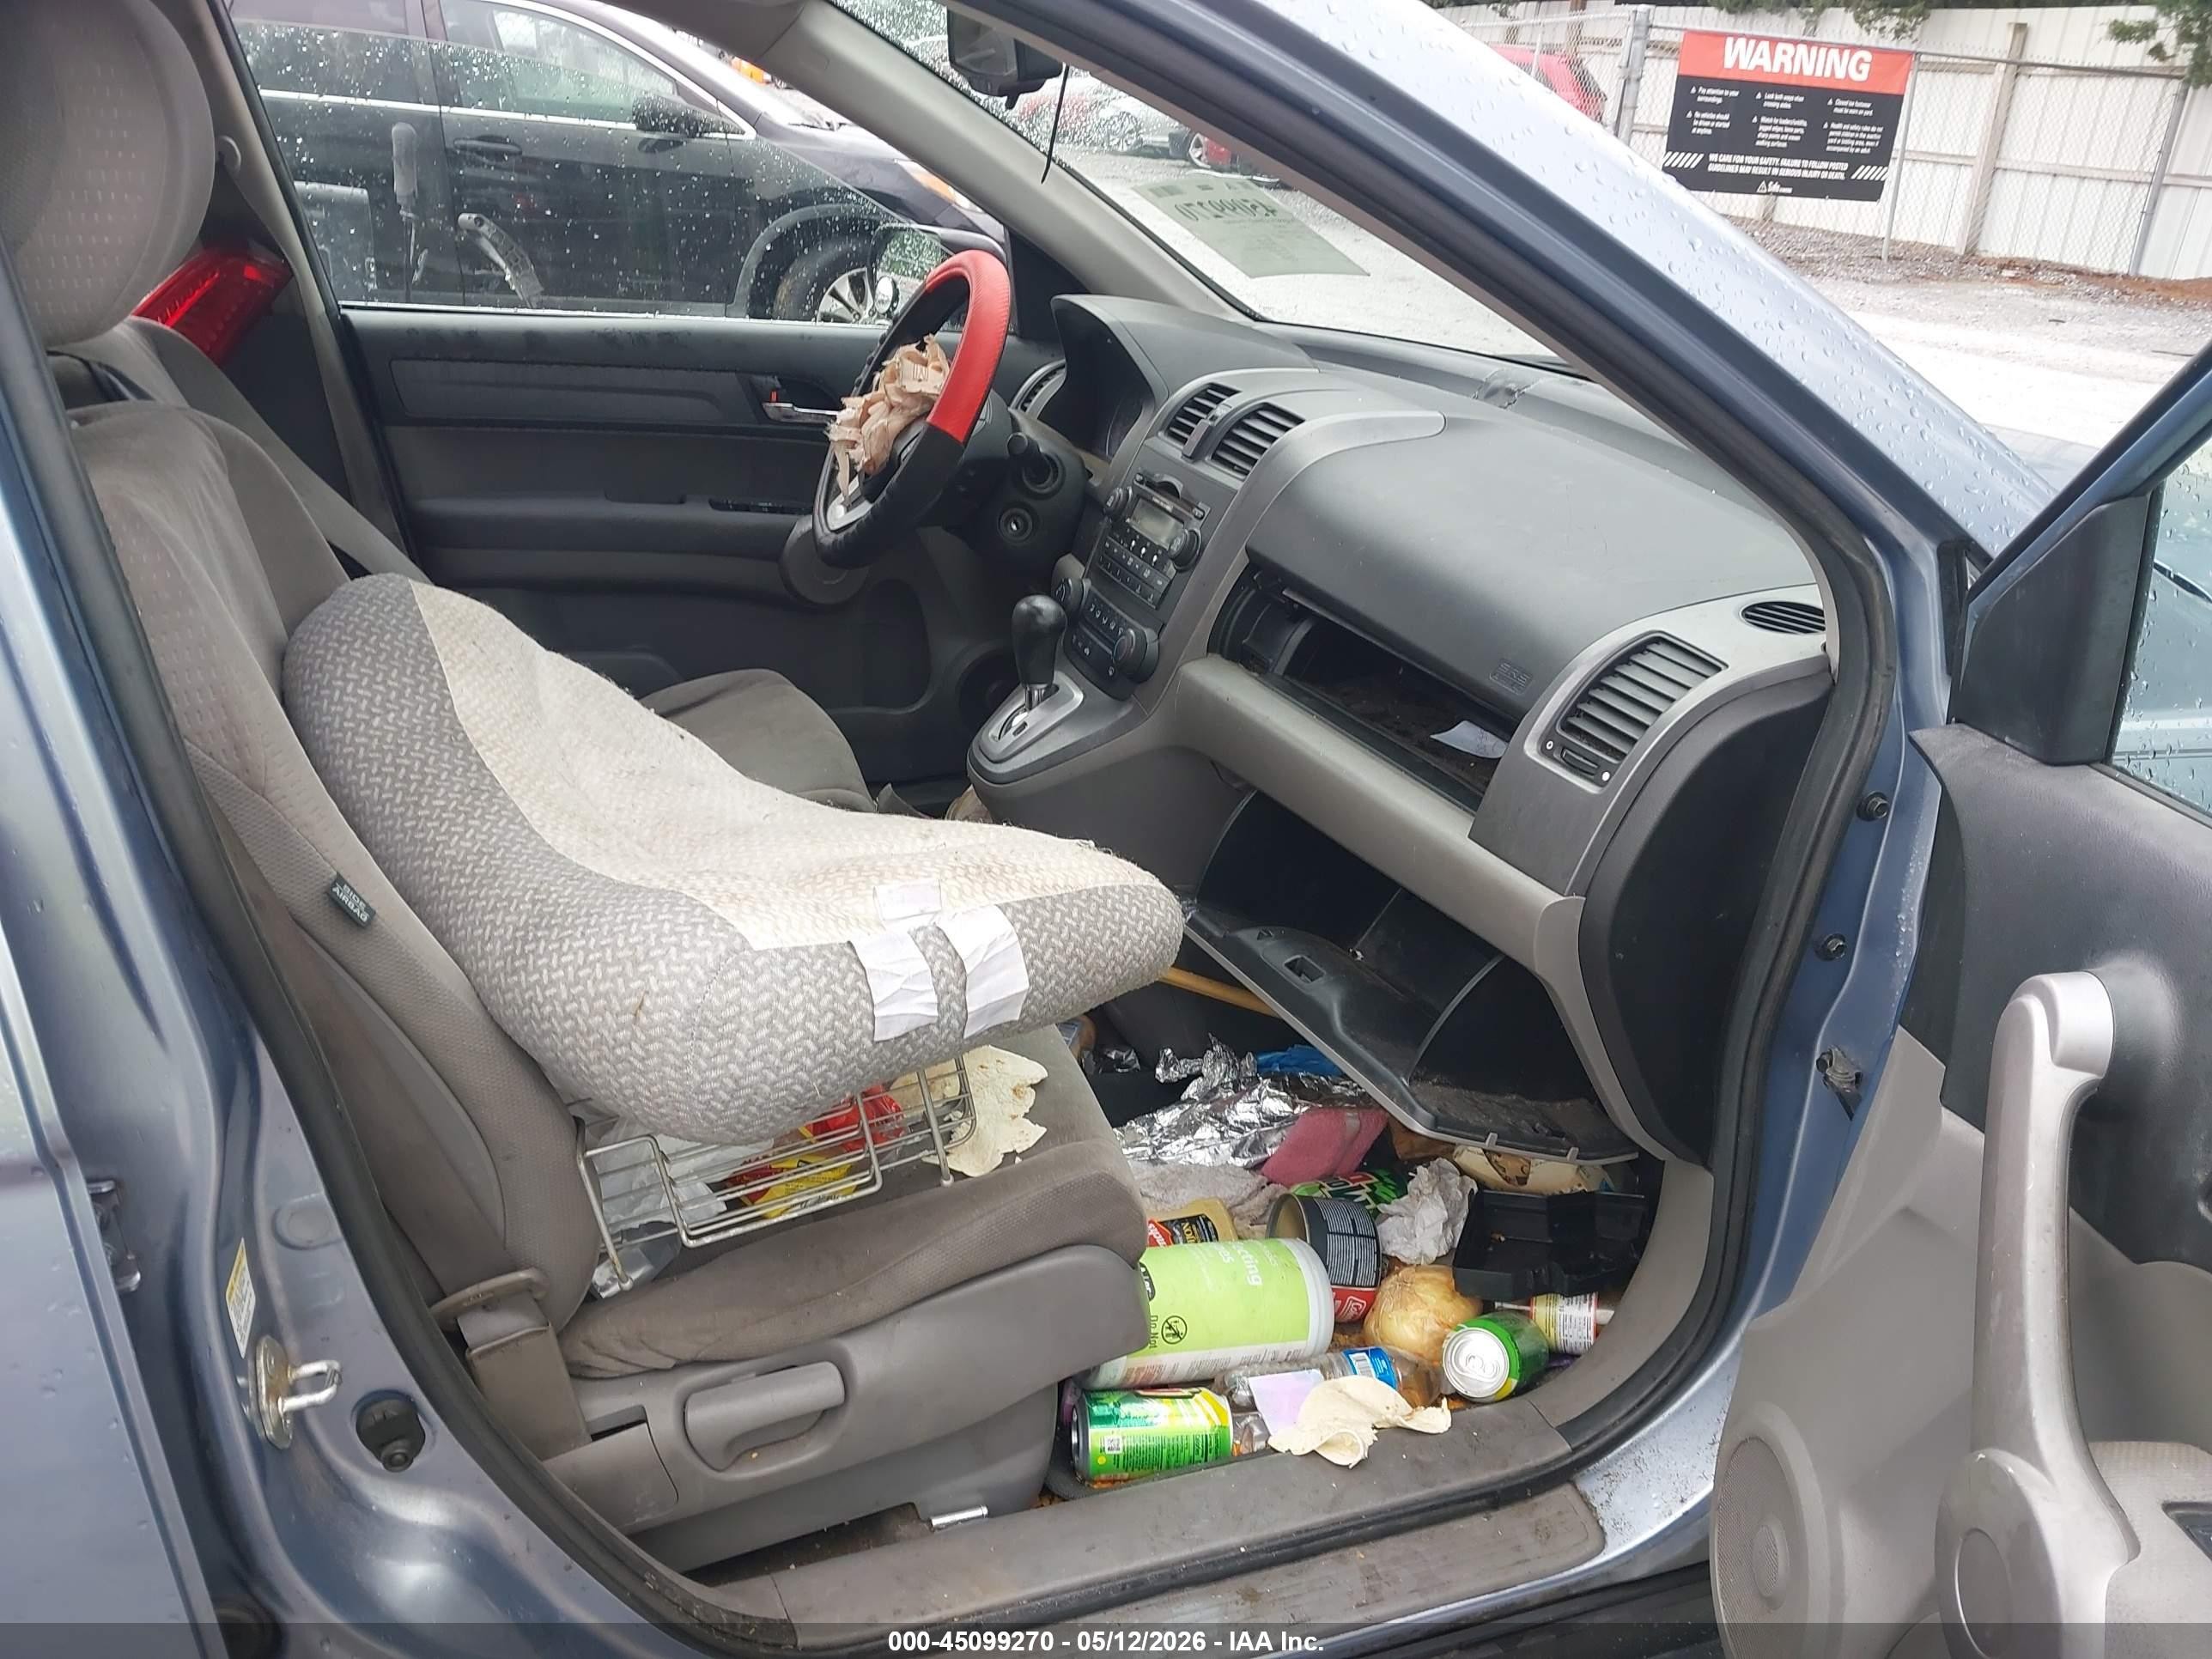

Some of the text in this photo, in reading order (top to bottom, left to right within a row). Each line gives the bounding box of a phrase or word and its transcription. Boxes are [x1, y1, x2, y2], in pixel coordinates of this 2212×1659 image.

[1723, 36, 1873, 82] WARNING
[1708, 162, 1739, 173] GUIDELINES
[1751, 165, 1772, 175] RESULT
[1778, 167, 1802, 177] SERIOUS
[1718, 153, 1733, 163] CARE
[1733, 155, 1745, 163] FOR
[1745, 155, 1760, 165] YOUR
[1802, 159, 1809, 168] TO
[1808, 160, 1829, 170] FOLLOW
[1828, 161, 1849, 171] POSTED
[332, 883, 370, 922] AIRBAG
[343, 884, 367, 910] SIDE
